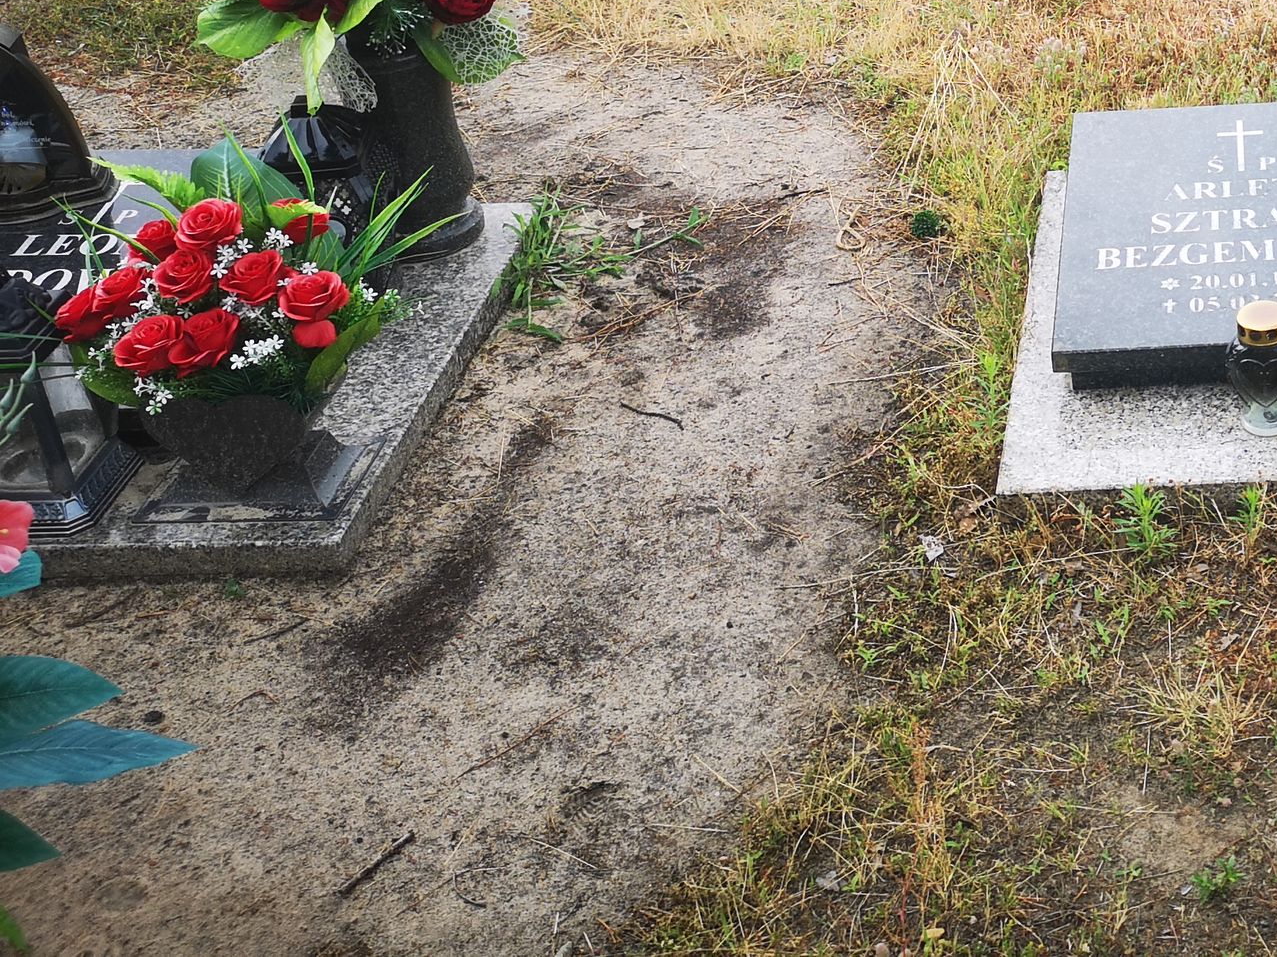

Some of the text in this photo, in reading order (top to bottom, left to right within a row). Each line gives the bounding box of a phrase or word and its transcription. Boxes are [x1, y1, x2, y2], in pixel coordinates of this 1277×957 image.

[1207, 154, 1276, 174] Ś P
[114, 209, 138, 224] P
